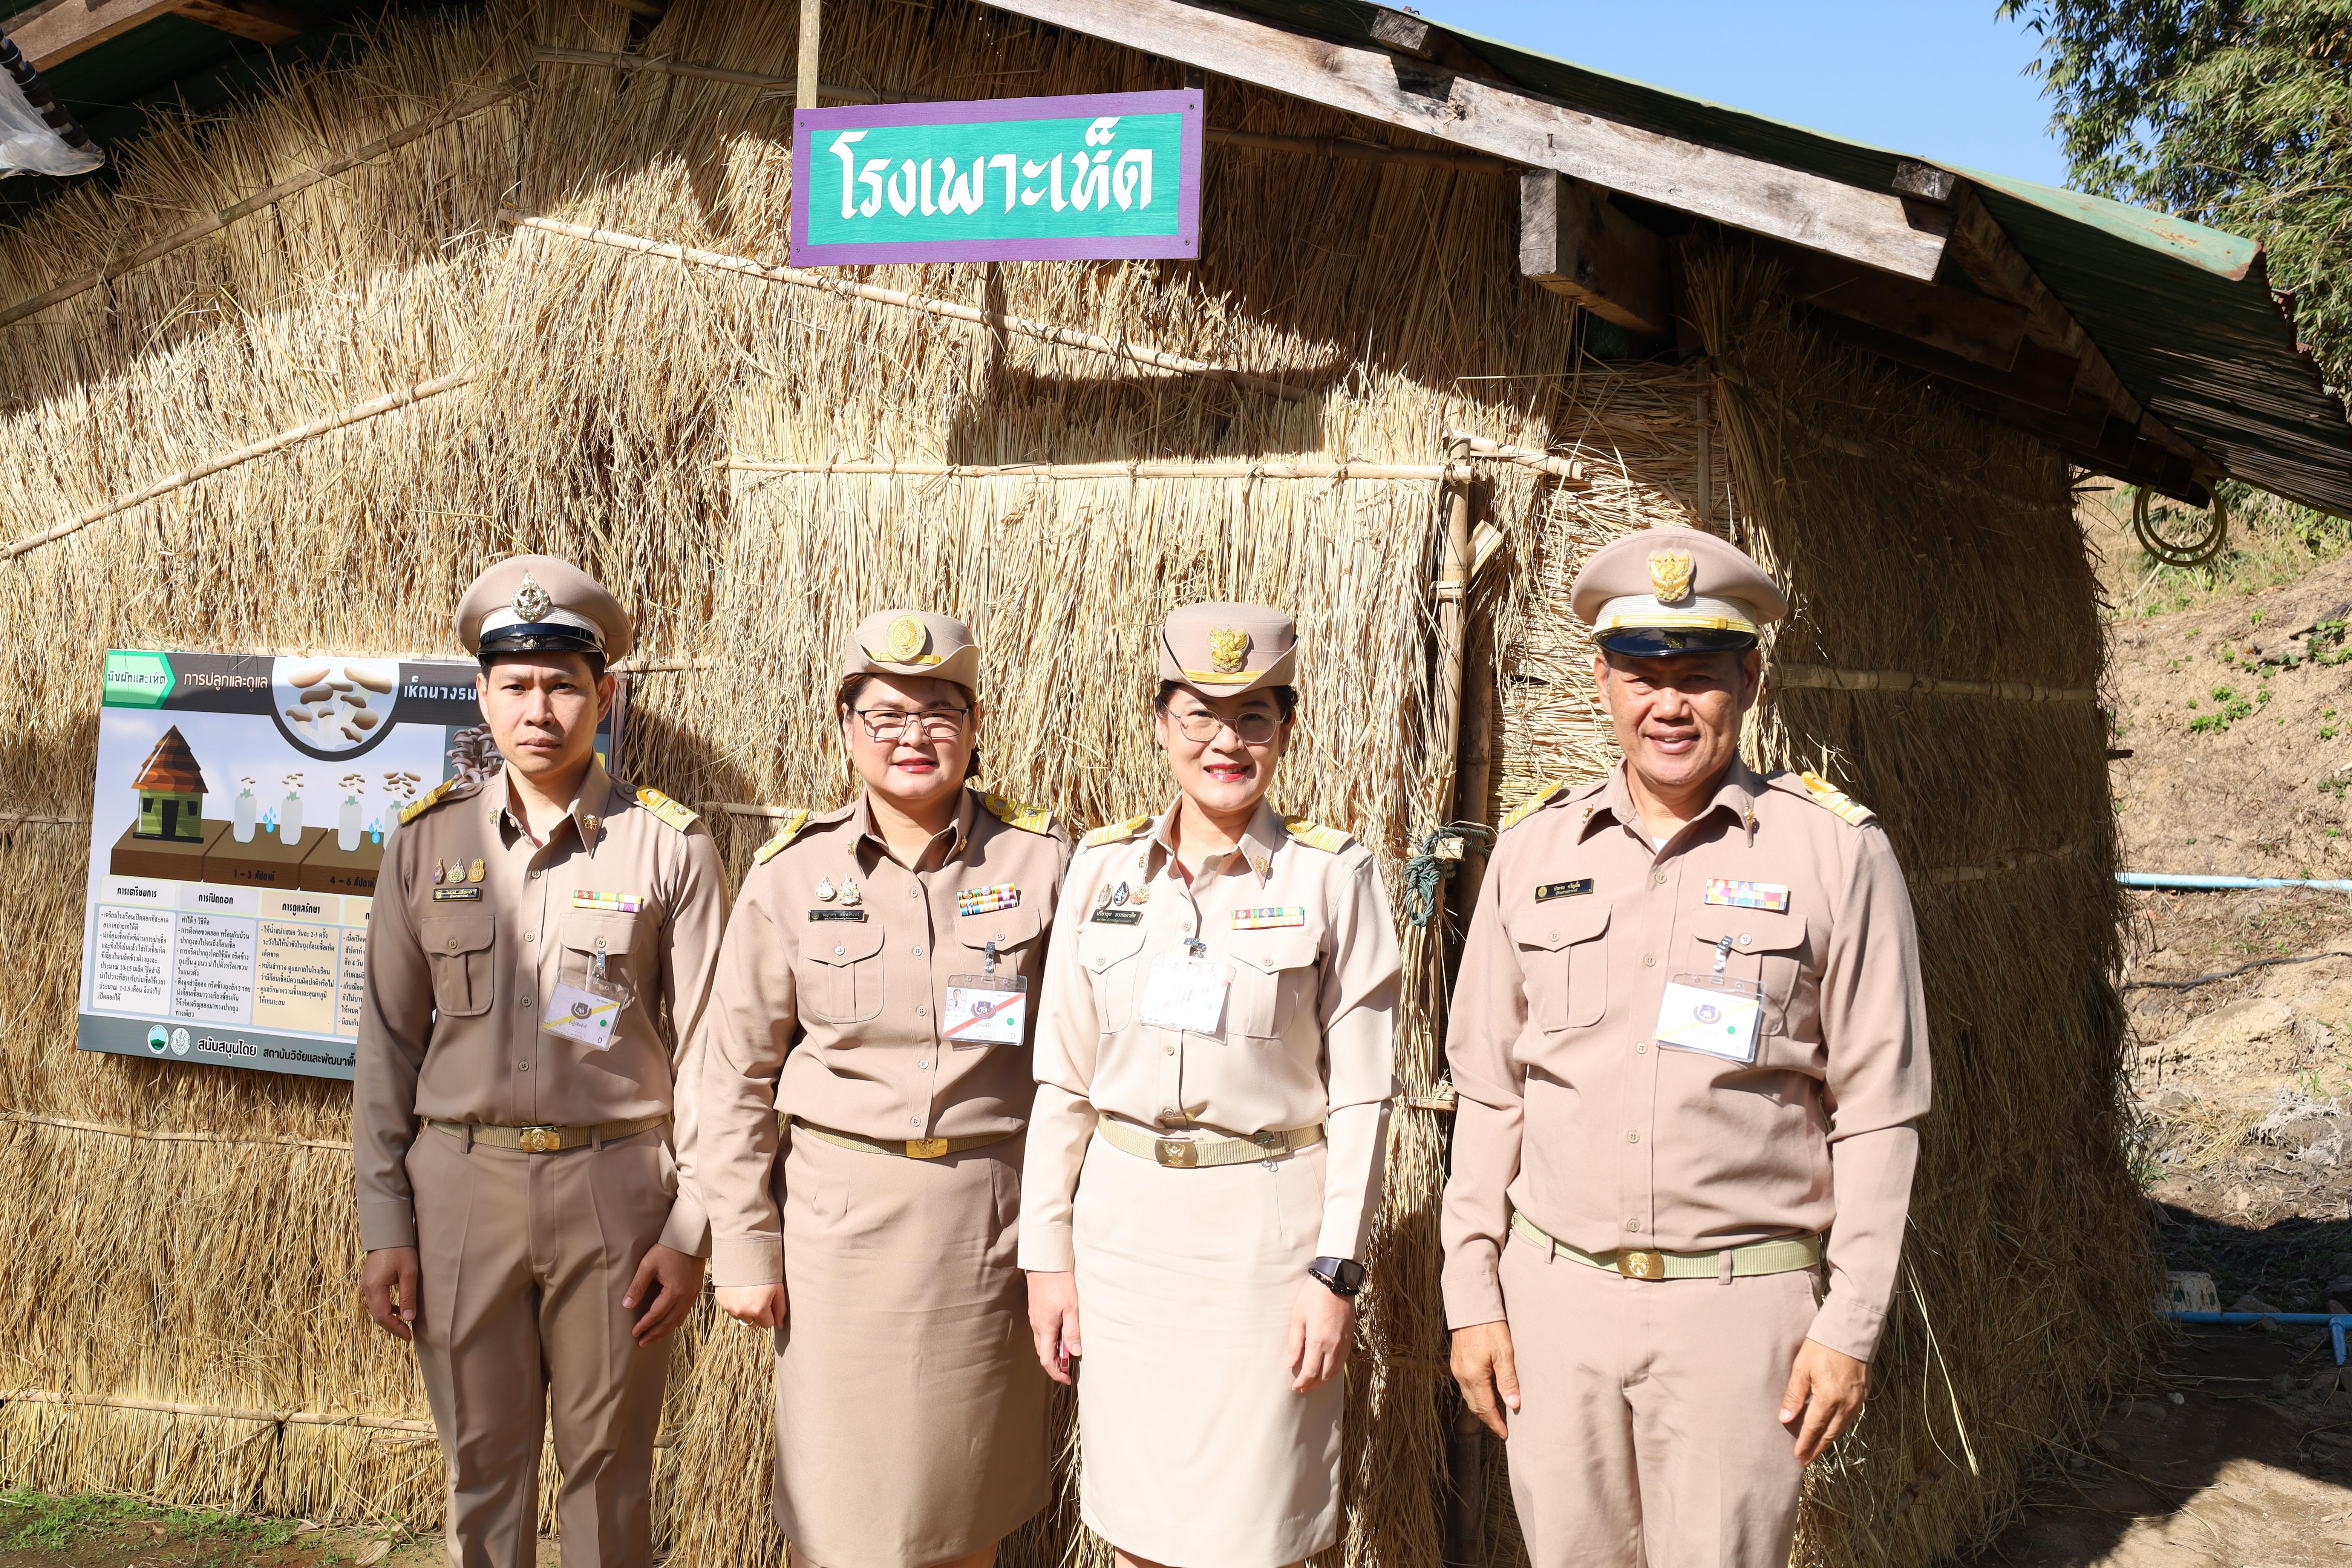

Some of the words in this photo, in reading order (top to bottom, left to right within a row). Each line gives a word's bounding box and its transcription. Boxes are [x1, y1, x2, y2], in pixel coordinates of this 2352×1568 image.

[828, 116, 1153, 219] โรงเพาะเห็ด
[108, 671, 165, 684] พืชผักและเห็ด
[184, 672, 268, 692] การปลูกและดูแล
[404, 675, 476, 701] เห็ดนางรม
[234, 870, 237, 878] 1
[248, 871, 251, 879] 3
[254, 870, 276, 881] สัปดาห์
[330, 876, 335, 884] 4
[354, 877, 376, 888] สัปดาห์
[117, 886, 157, 898] การเตรียมการ
[199, 893, 233, 904] การเปิดดอก
[282, 903, 320, 916] การดูแลรักษา
[104, 911, 169, 923] เตรียมโรงเรือนเปิดดอกที่สะอาด
[103, 922, 138, 931] อากาศถ่ายเทได้ดี
[181, 926, 219, 936] การดึงคอขวดออก
[220, 929, 249, 939] พร้อมกับม้วน
[319, 928, 328, 939] ครั้ง
[180, 937, 235, 948] ปากถุงลงไปจนถึงก้อนเชื้อ
[262, 949, 279, 958] เด็ดขาด
[345, 946, 362, 954] สัปดาห์
[101, 962, 118, 970] ประมาณ
[145, 966, 160, 974] ปิดสำลี
[288, 965, 330, 975] ดูแลภายในโรงเรือน
[144, 986, 161, 995] จึงนำไป
[98, 992, 121, 1001] เปิดดอกได้
[259, 996, 285, 1006] ให้เหมาะสม
[341, 1004, 358, 1014] ให้หมด
[198, 1037, 257, 1058] สนับสนุนโดย
